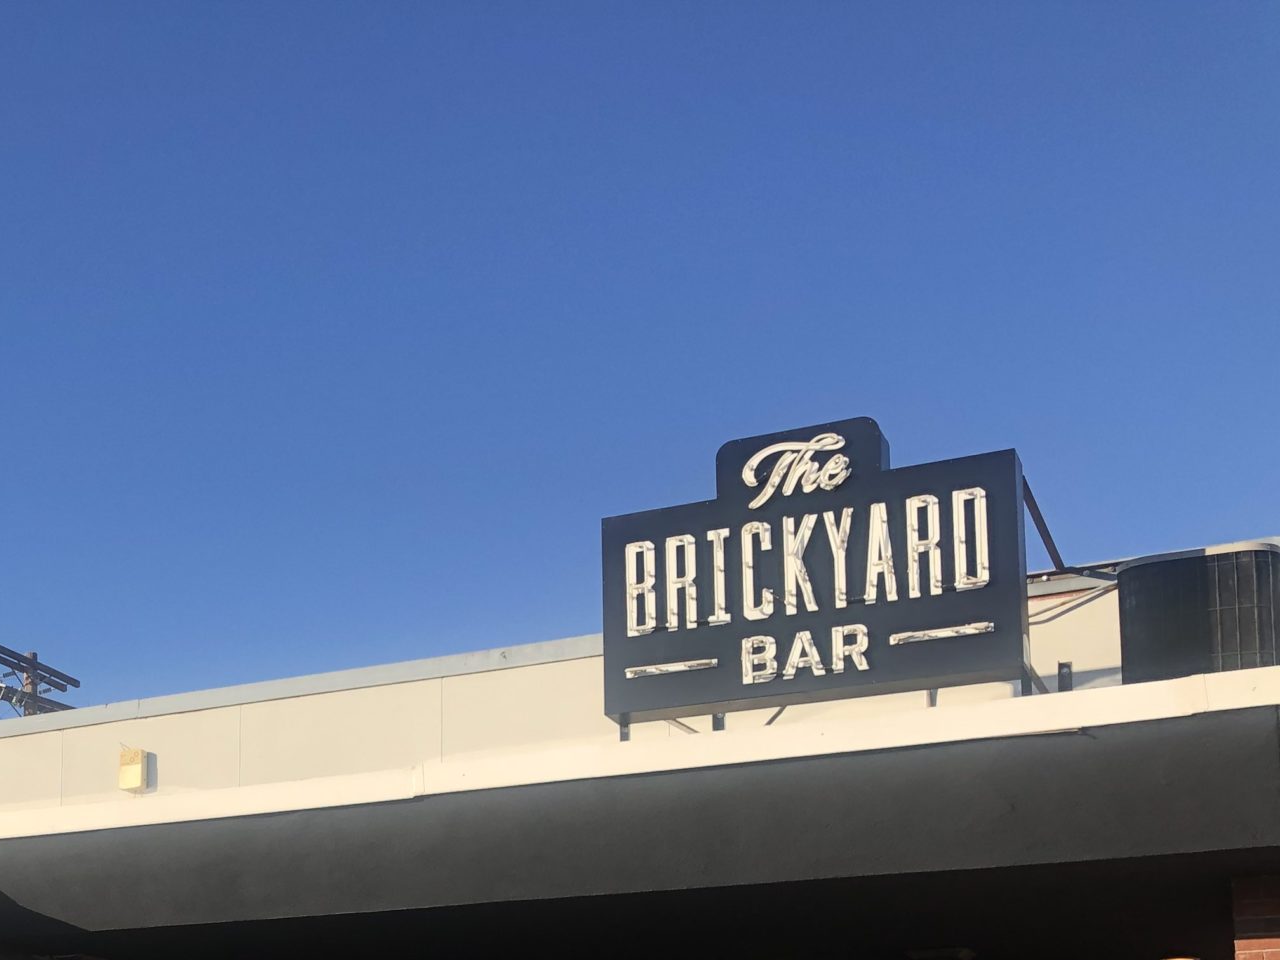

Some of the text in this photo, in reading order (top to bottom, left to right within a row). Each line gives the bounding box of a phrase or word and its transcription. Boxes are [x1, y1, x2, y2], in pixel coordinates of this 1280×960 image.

[742, 432, 852, 510] The
[625, 487, 991, 638] BRICKYARD
[742, 624, 870, 685] BAR
